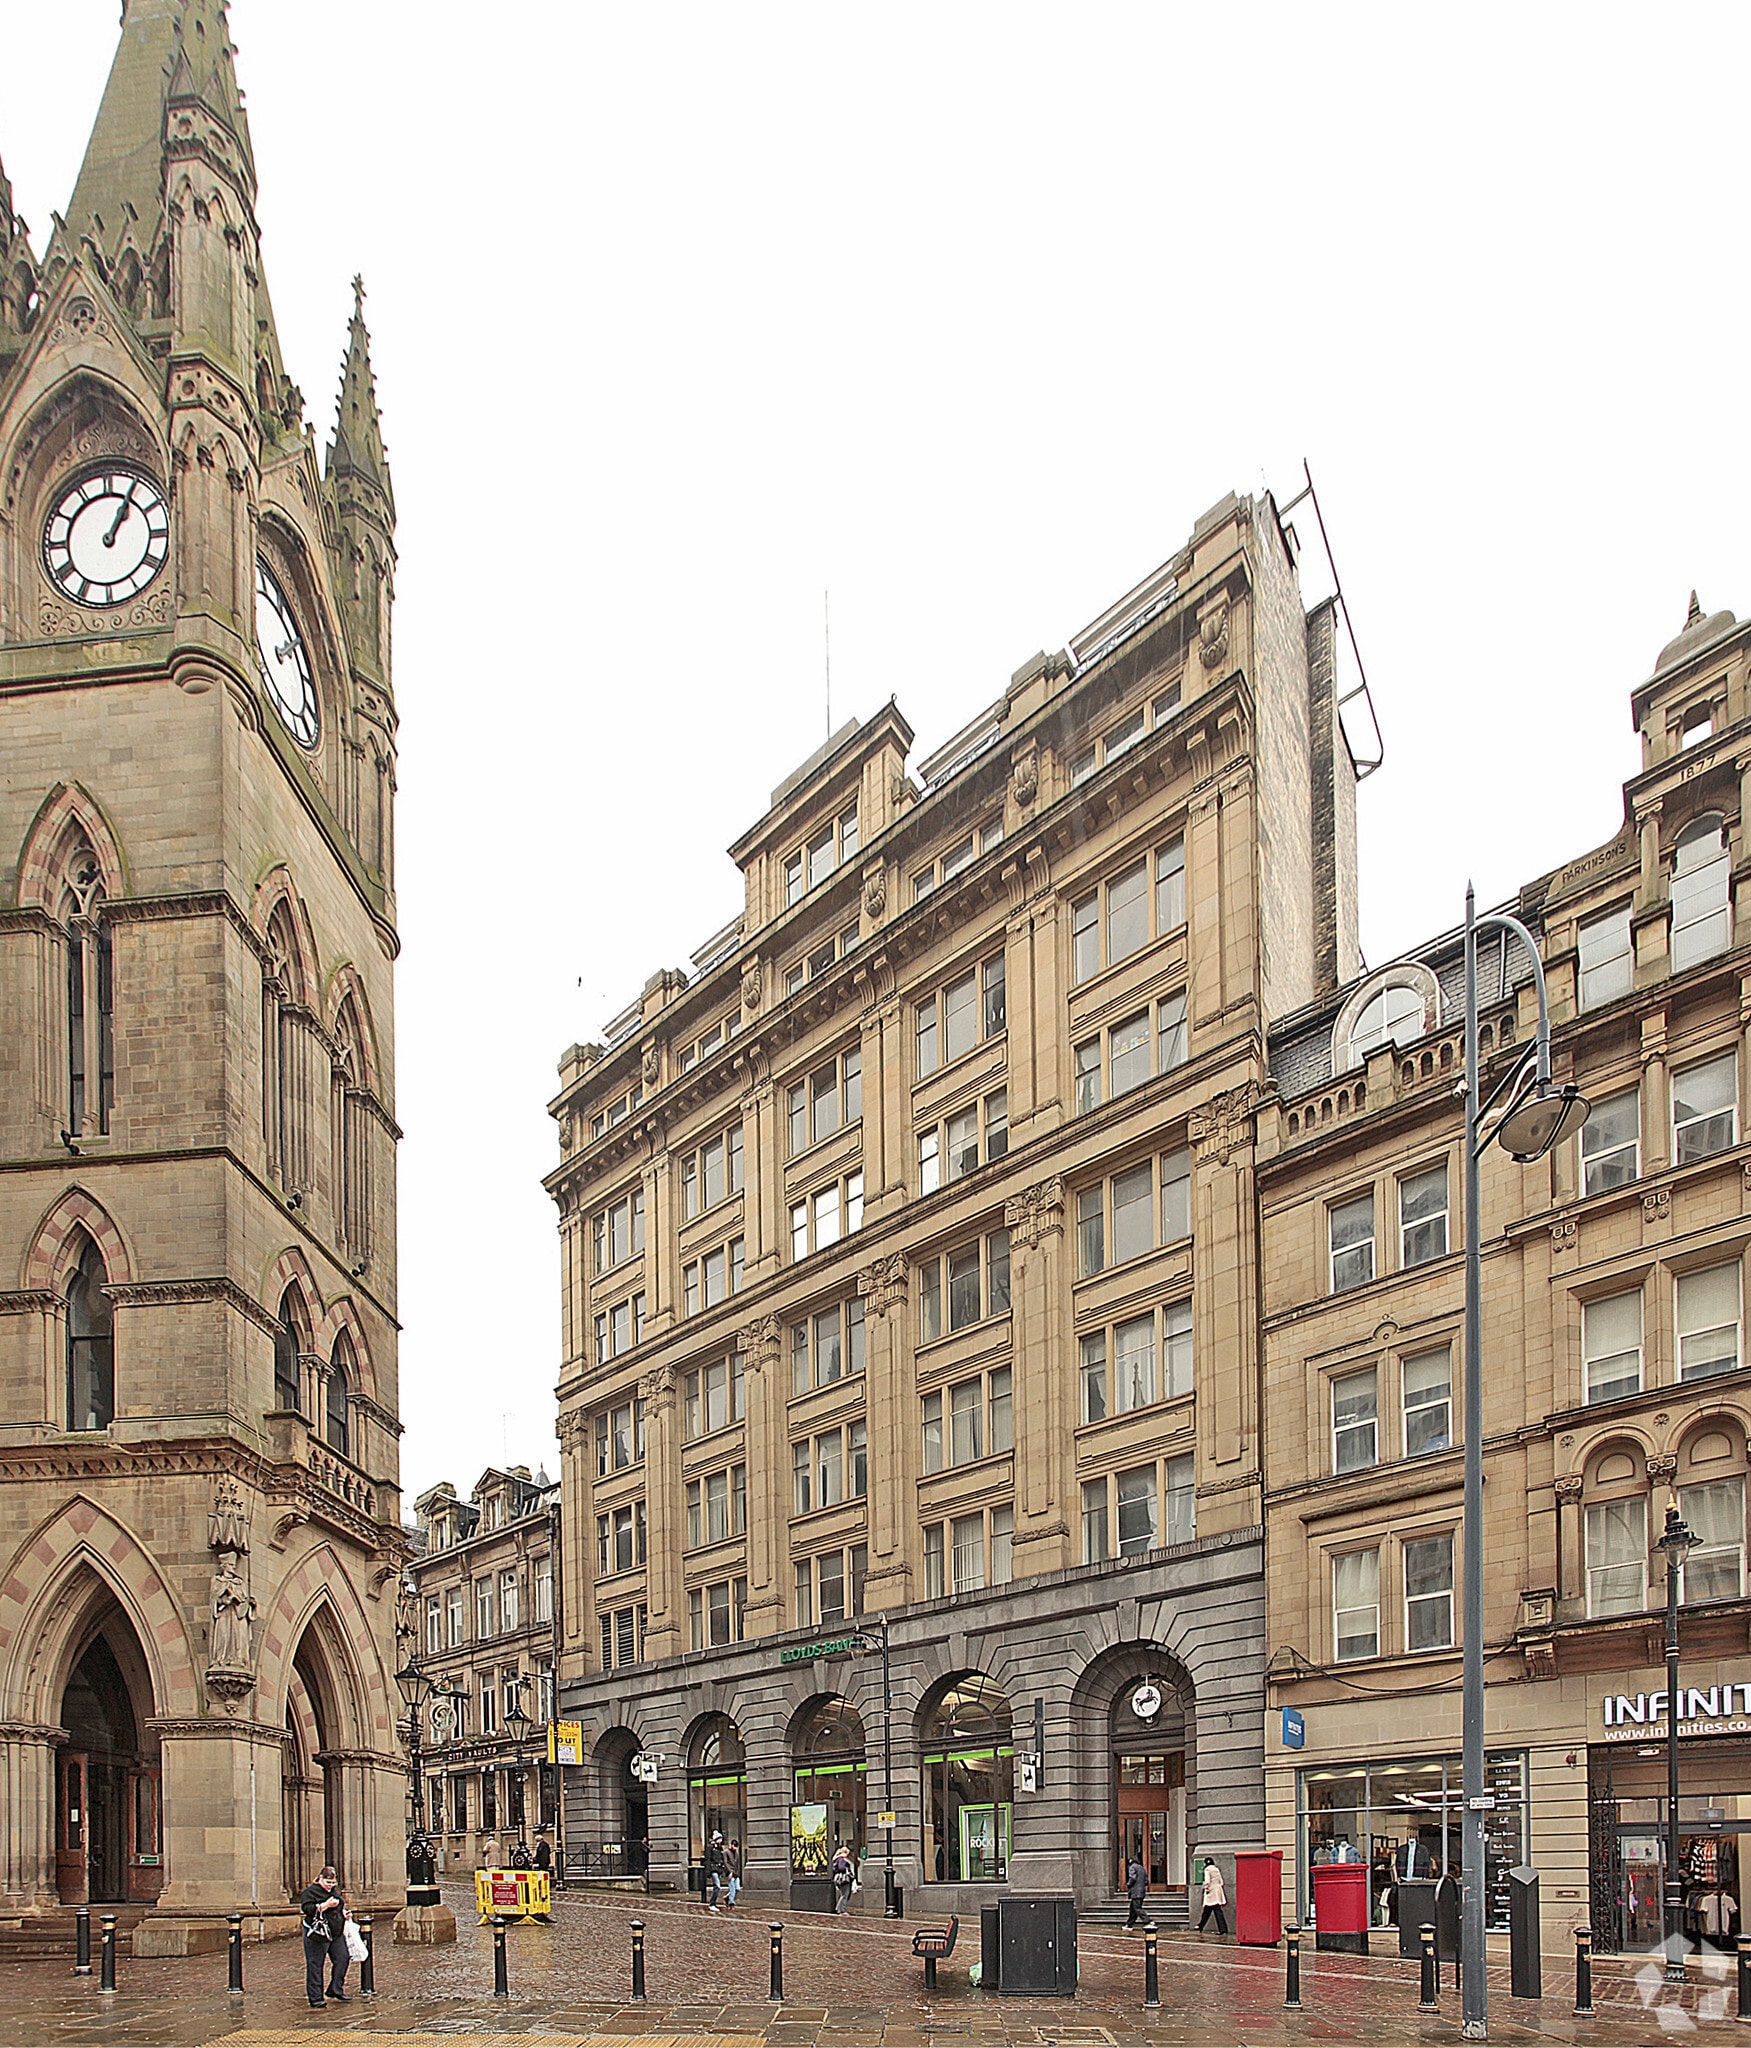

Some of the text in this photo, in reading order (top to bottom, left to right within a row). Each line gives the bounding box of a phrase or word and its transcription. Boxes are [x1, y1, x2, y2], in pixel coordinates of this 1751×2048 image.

[1680, 754, 1716, 782] 1877
[781, 1643, 822, 1663] LLOYDS
[468, 1746, 497, 1757] VAULTS
